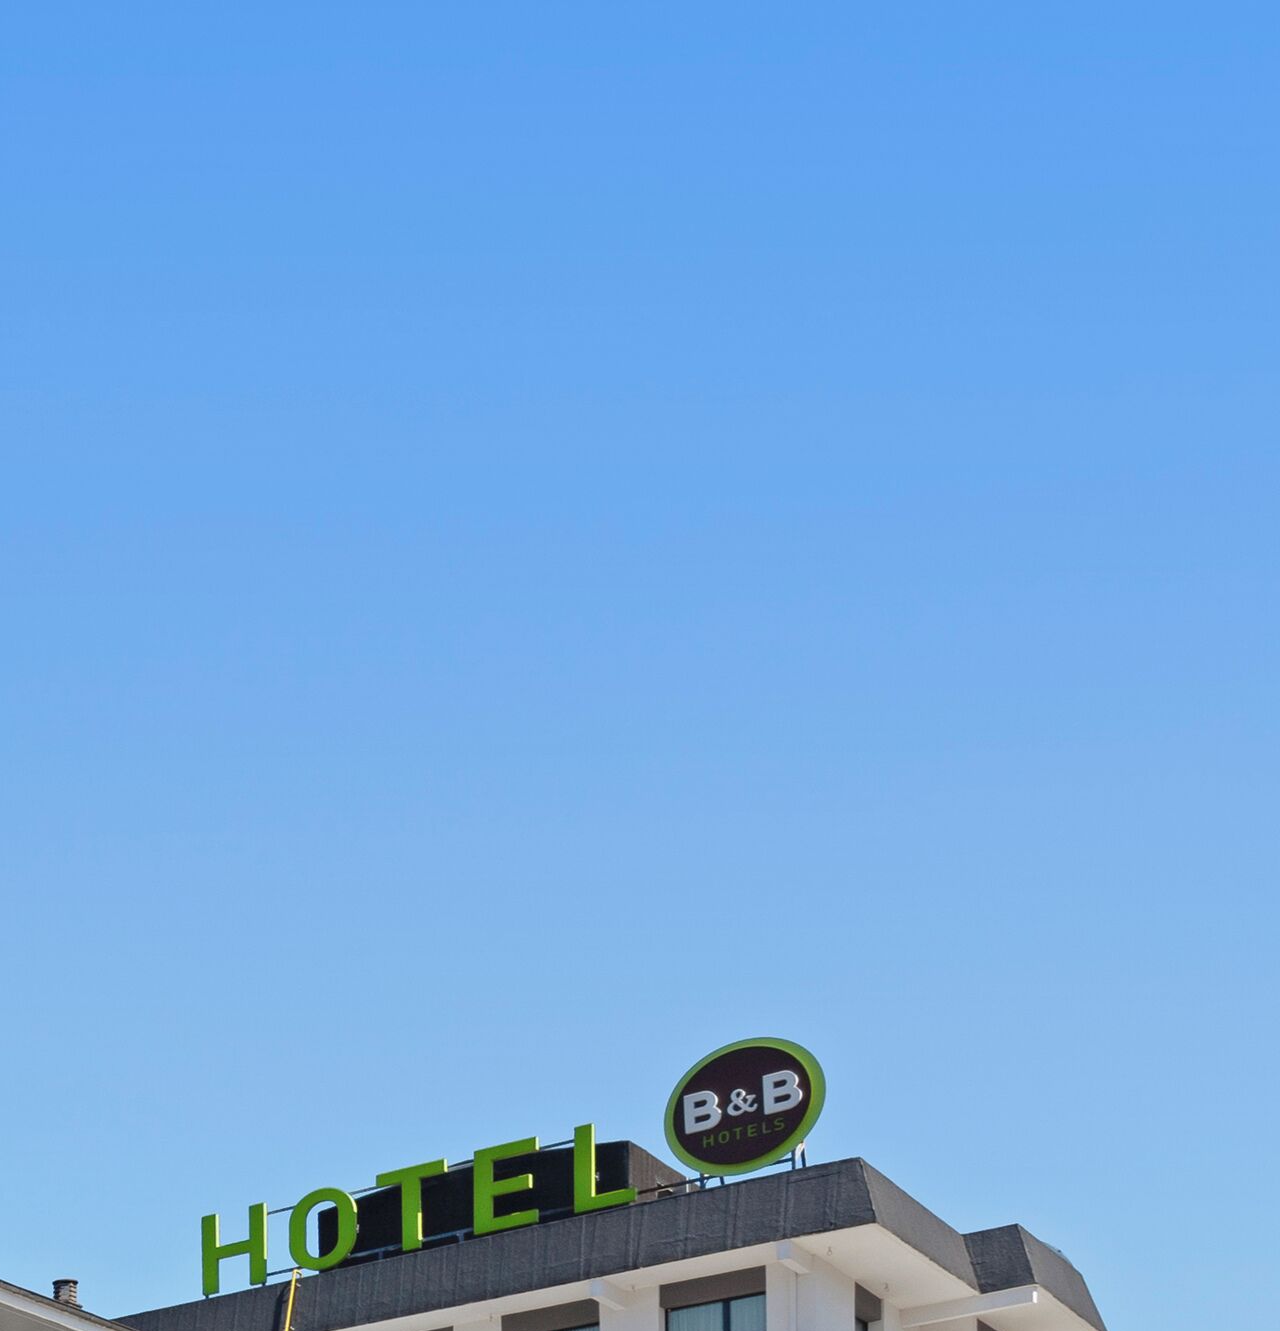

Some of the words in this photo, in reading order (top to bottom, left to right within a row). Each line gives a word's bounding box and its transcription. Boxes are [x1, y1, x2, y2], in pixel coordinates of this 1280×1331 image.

[683, 1069, 804, 1135] B&B
[702, 1117, 786, 1149] HOTELS
[201, 1122, 638, 1296] HOTEL
